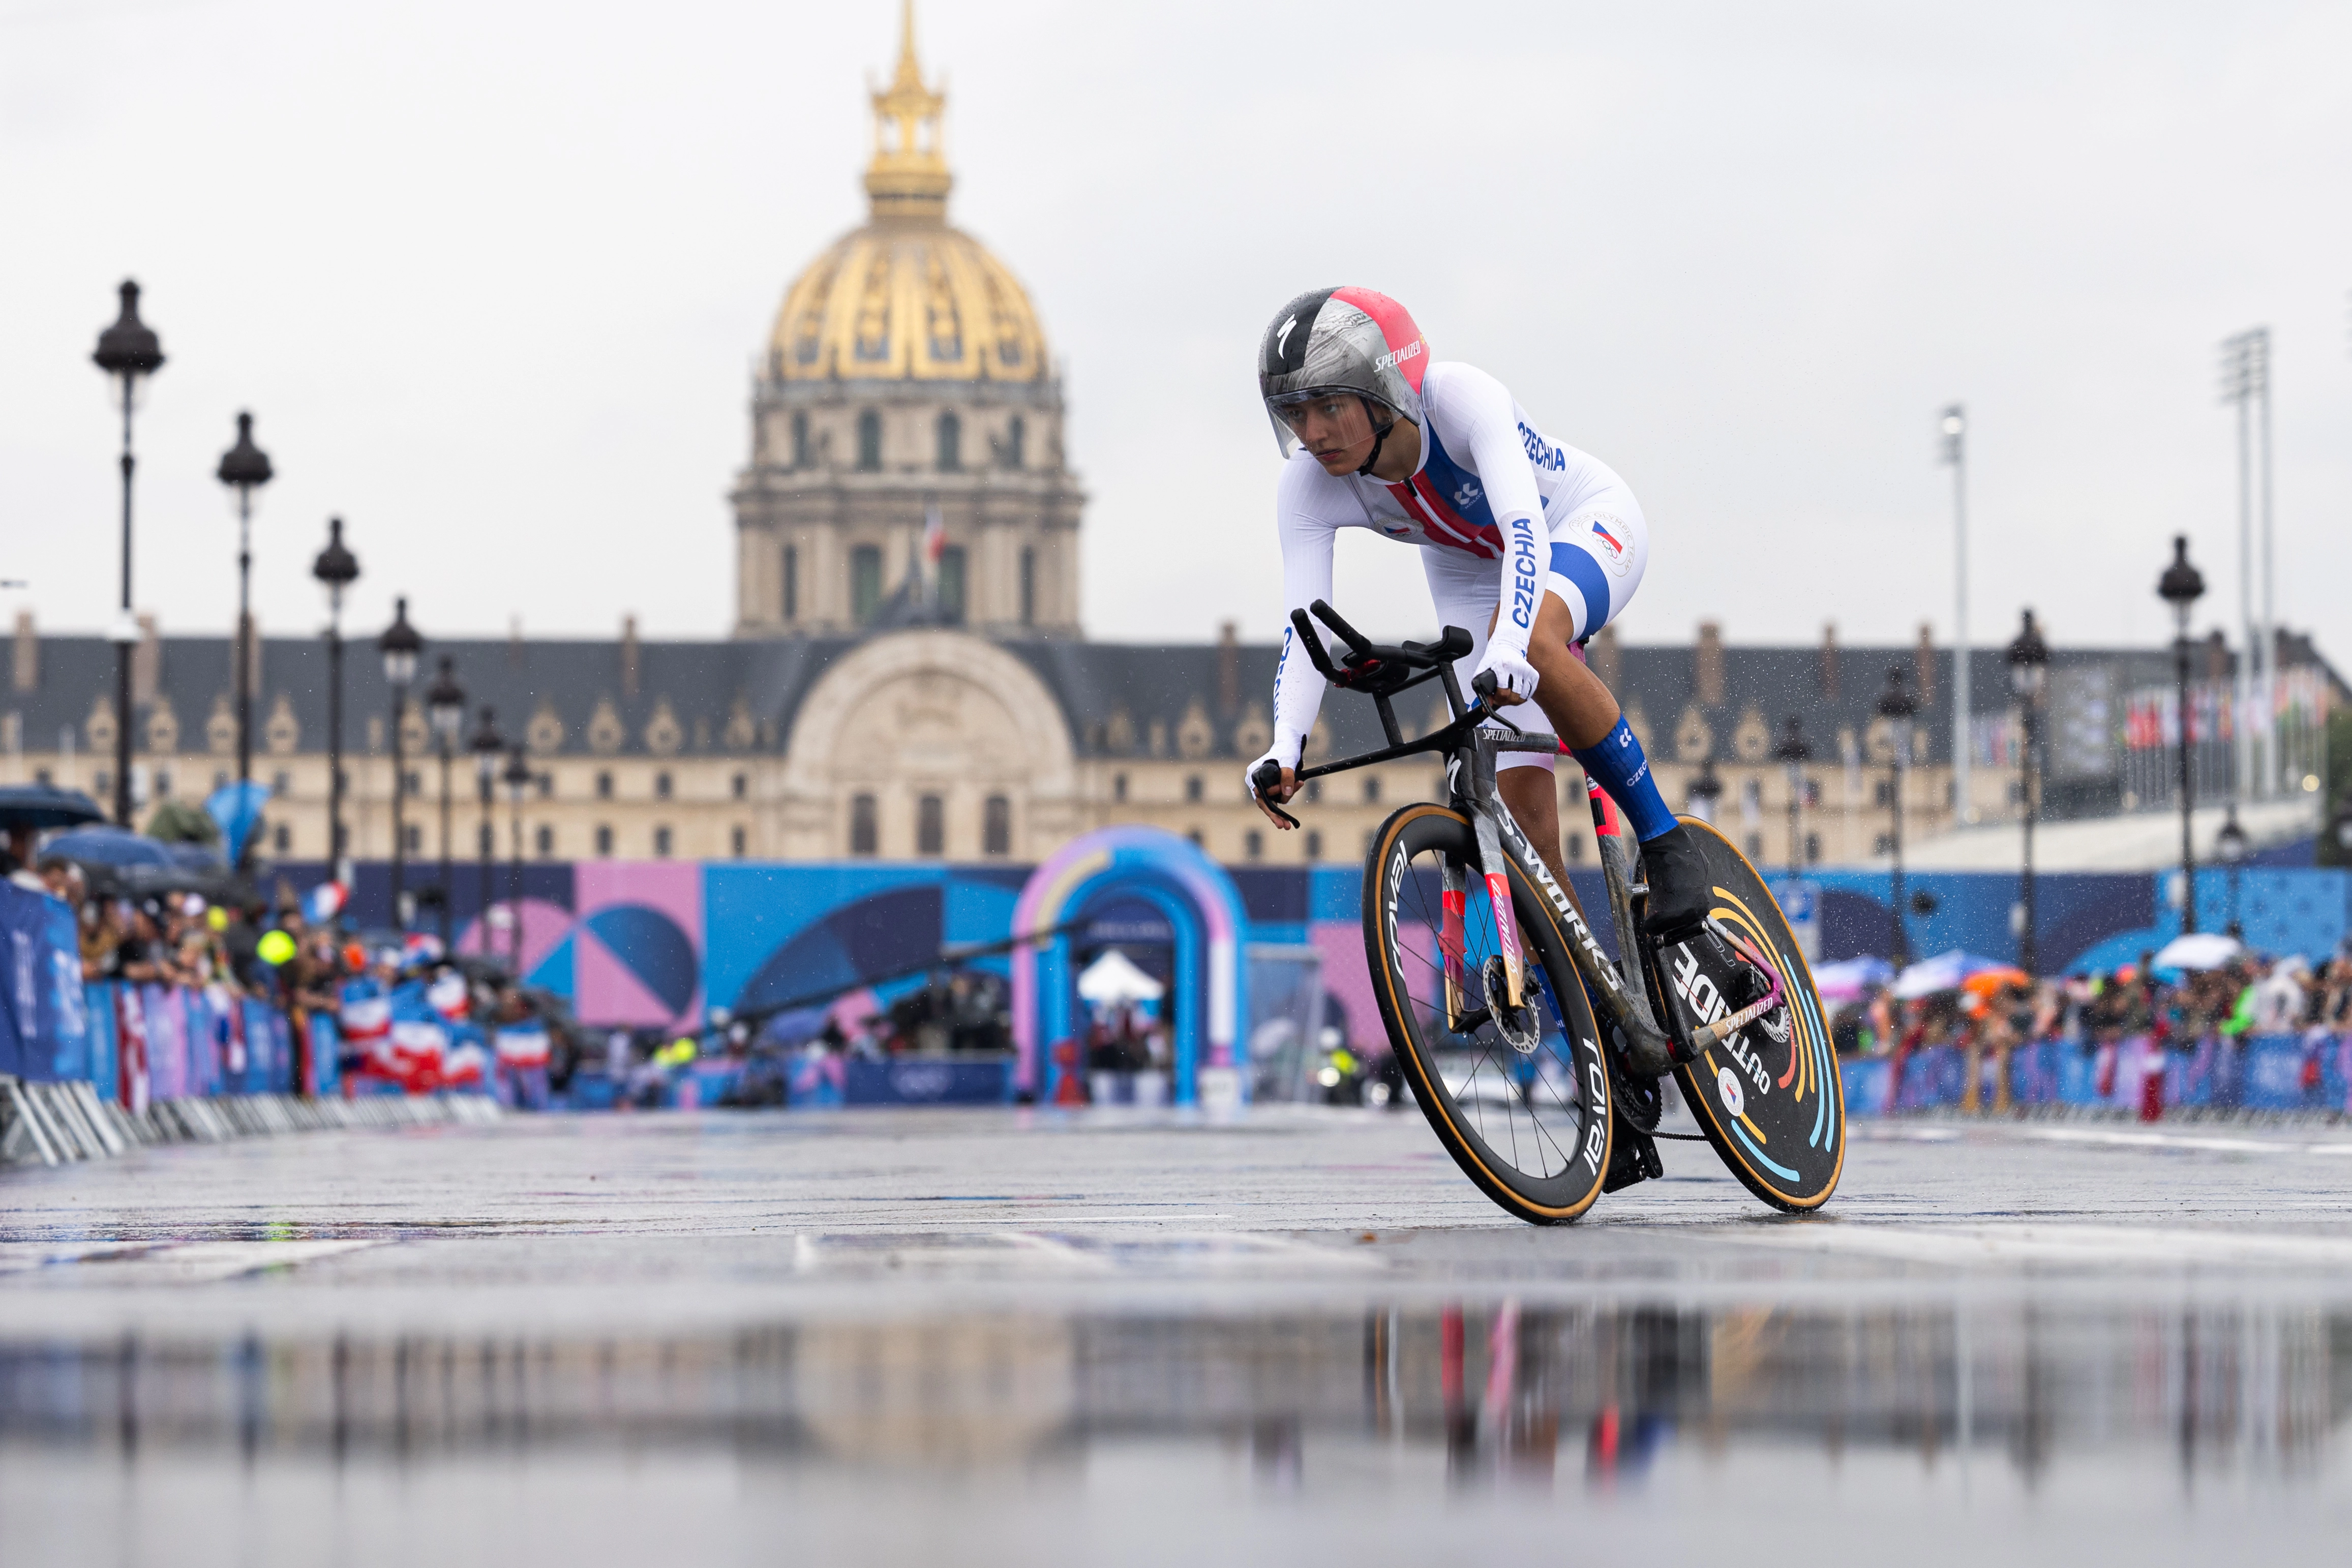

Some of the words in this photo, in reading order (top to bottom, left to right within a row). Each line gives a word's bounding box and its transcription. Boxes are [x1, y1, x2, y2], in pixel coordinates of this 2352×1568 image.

[1374, 340, 1421, 373] SPECIALIZED
[1512, 518, 1536, 629] CZECHIA
[1572, 515, 1592, 527] CZECH
[1594, 512, 1632, 541] OLYMPIC
[1625, 546, 1634, 571] TEAM
[1491, 878, 1520, 980] SPECIALIZED
[1497, 809, 1626, 991] S-WORKS
[1725, 997, 1773, 1035] SPECIALIZED
[1583, 1037, 1606, 1177] roval
